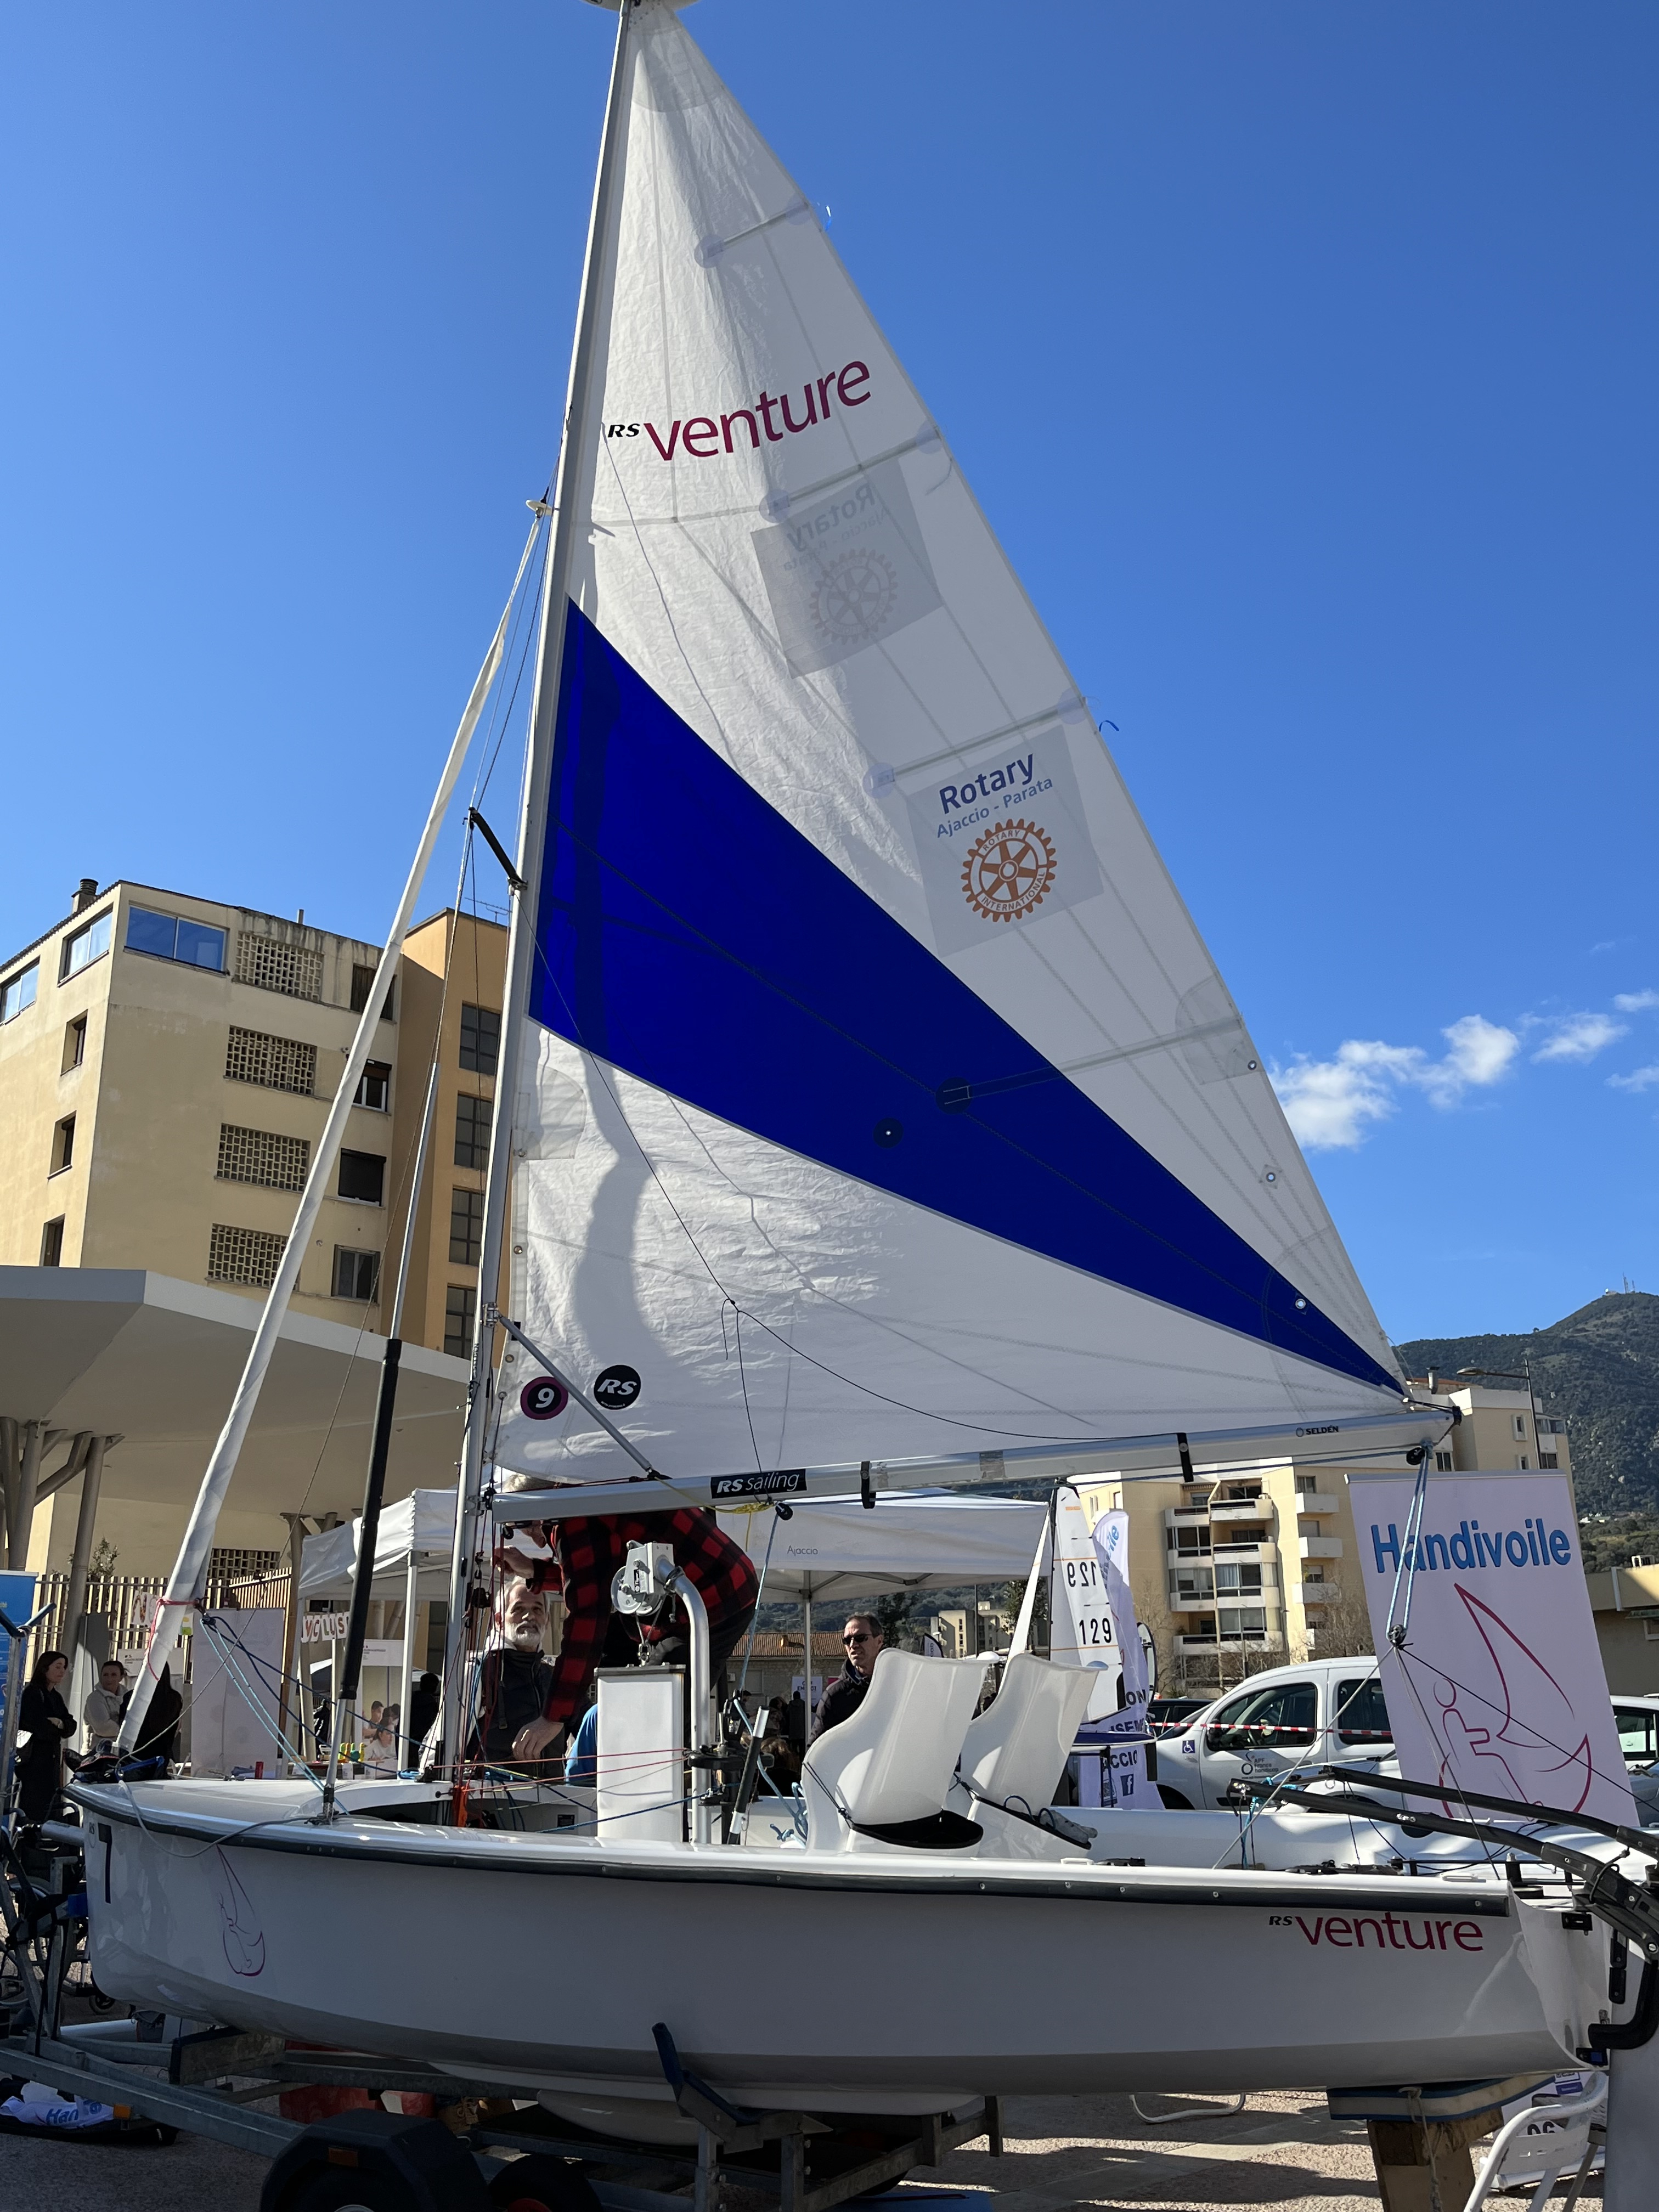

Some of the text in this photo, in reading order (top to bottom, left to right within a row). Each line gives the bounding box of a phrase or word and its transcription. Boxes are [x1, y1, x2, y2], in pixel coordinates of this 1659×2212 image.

[607, 361, 872, 461] RS venture
[939, 753, 1034, 814] Rotary
[936, 807, 990, 838] Ajaccio
[1003, 778, 1053, 809] Parata
[983, 829, 1021, 851] ROTARY
[981, 871, 1046, 911] INTERNATIONAL
[535, 1387, 555, 1408] 9
[597, 1379, 637, 1395] RS
[716, 1471, 800, 1493] RS sailing
[787, 1544, 819, 1557] Ajaccio
[1370, 1517, 1572, 1574] Handivoile
[1079, 1617, 1112, 1645] 129
[1268, 1911, 1484, 1952] RS venture
